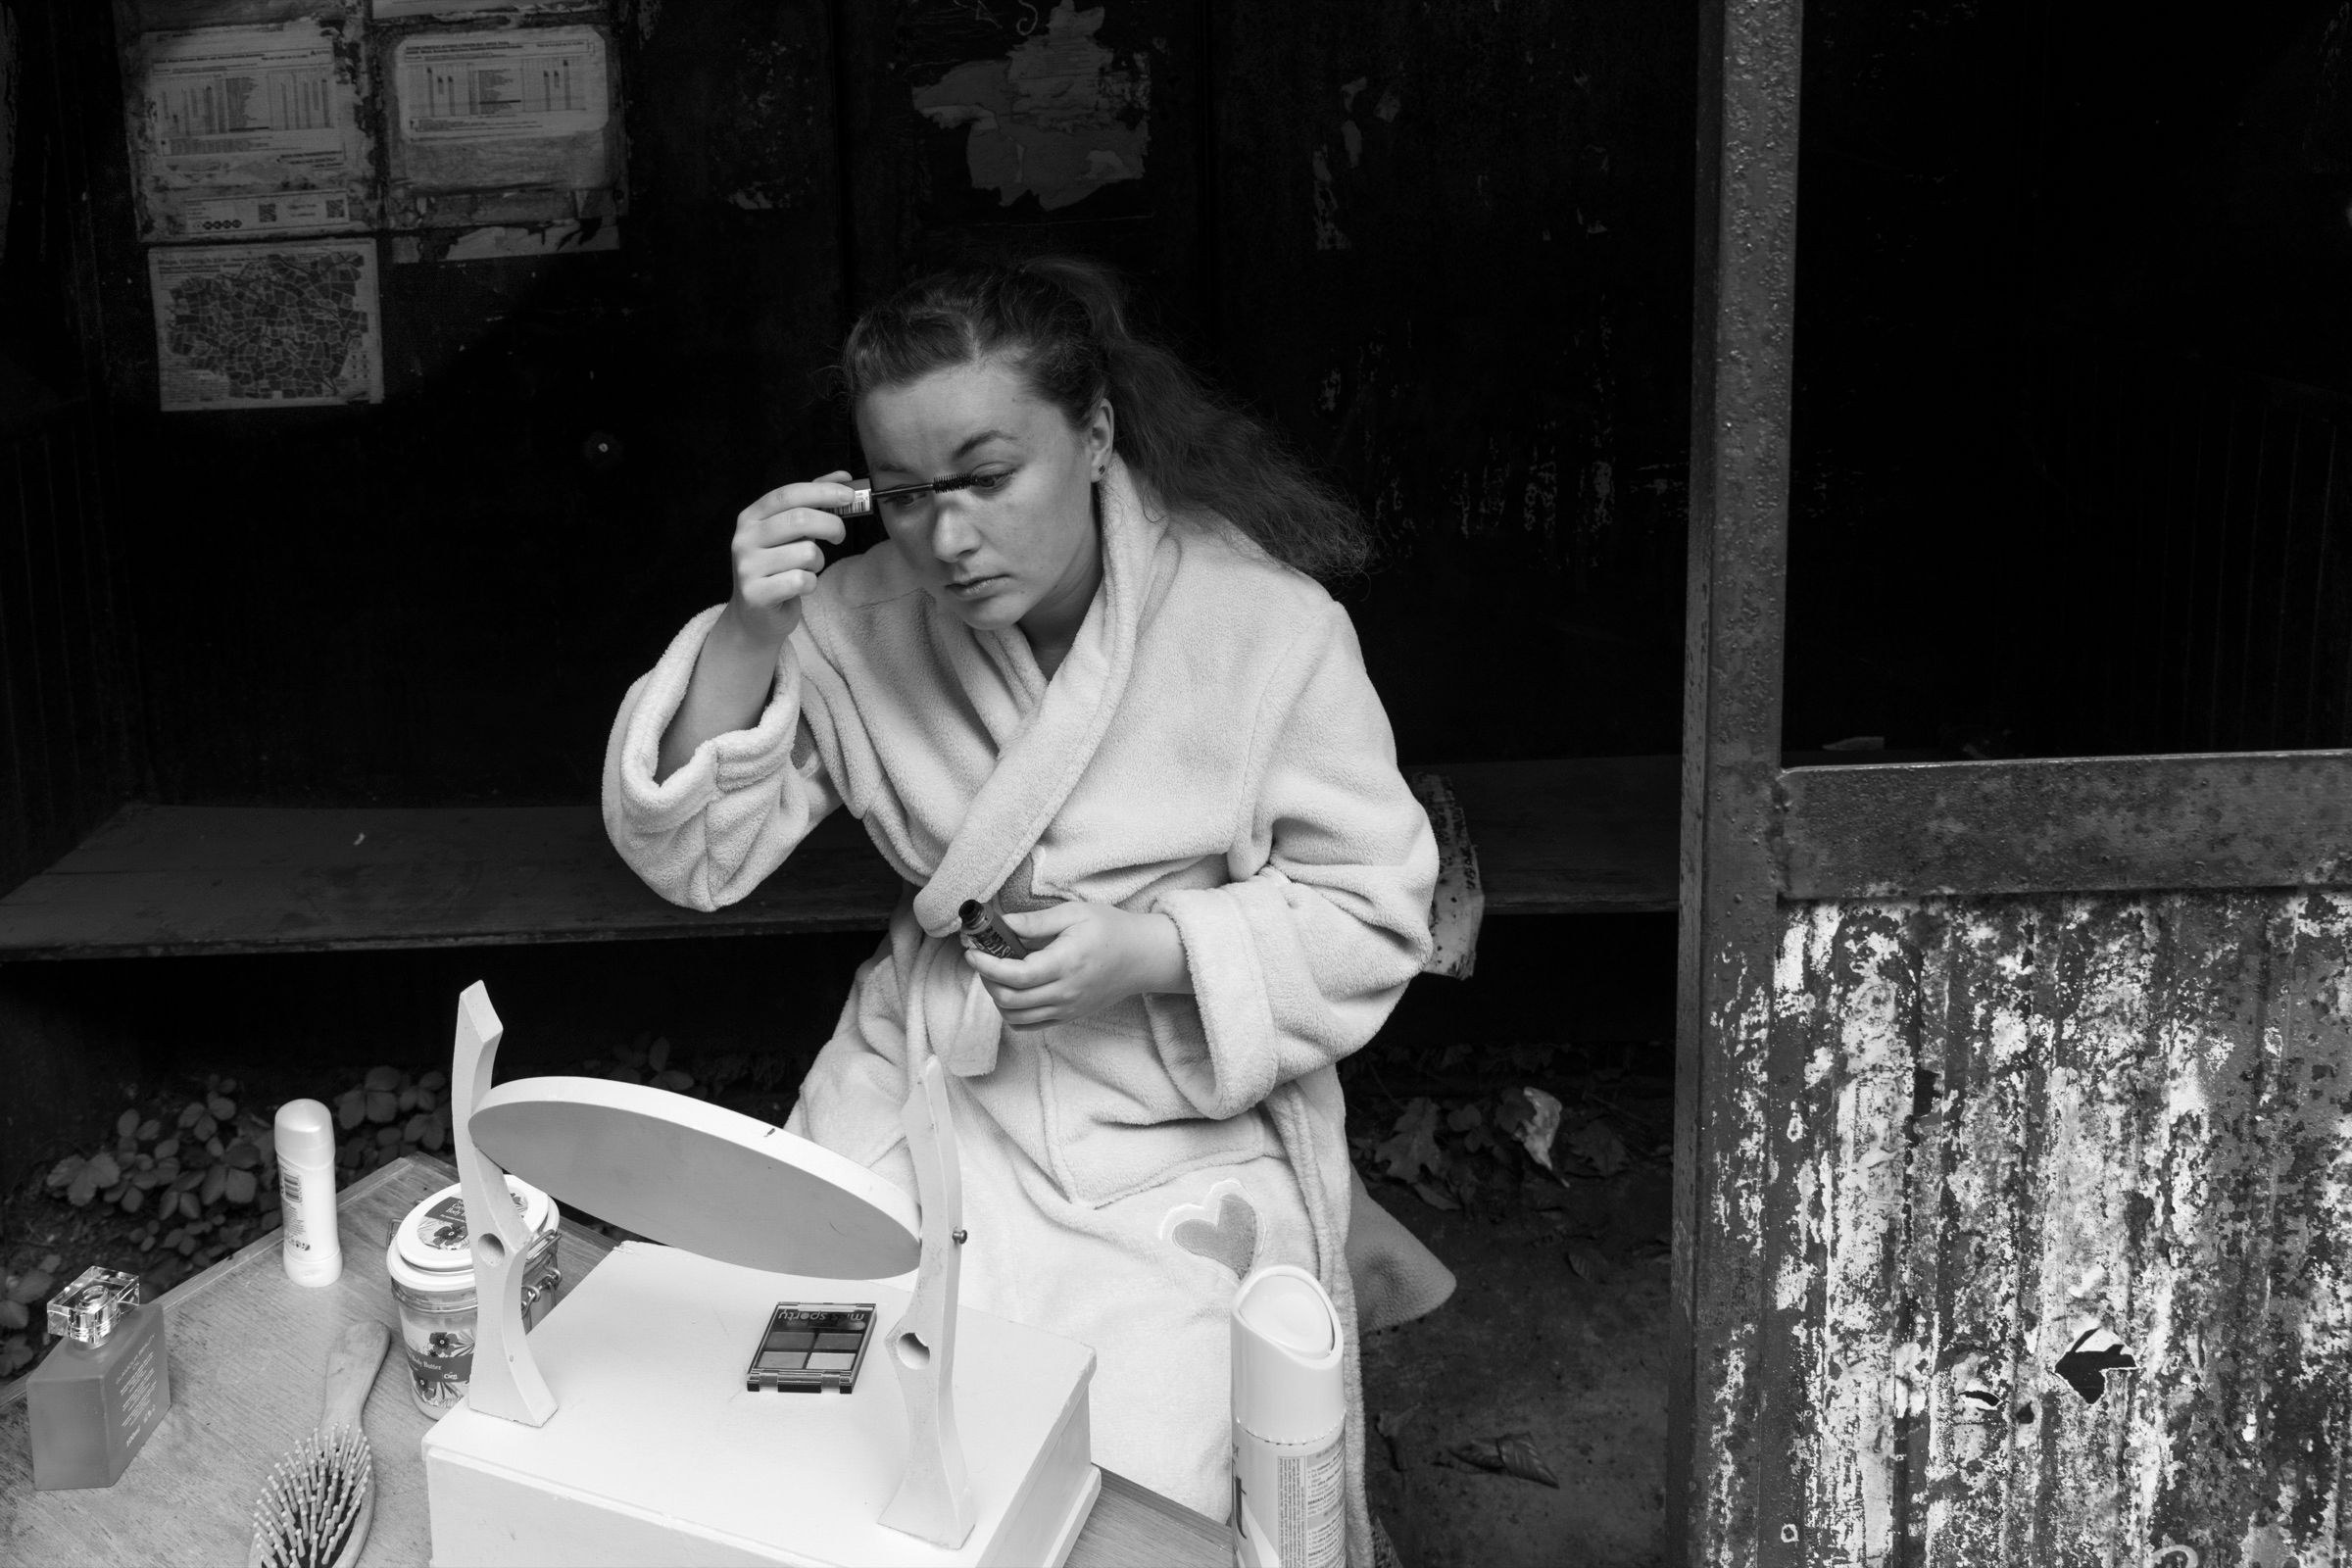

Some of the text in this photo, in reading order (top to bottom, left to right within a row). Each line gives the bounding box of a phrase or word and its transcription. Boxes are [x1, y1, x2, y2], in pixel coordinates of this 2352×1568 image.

[778, 1309, 864, 1322] mis sporty
[423, 1360, 441, 1370] Butter
